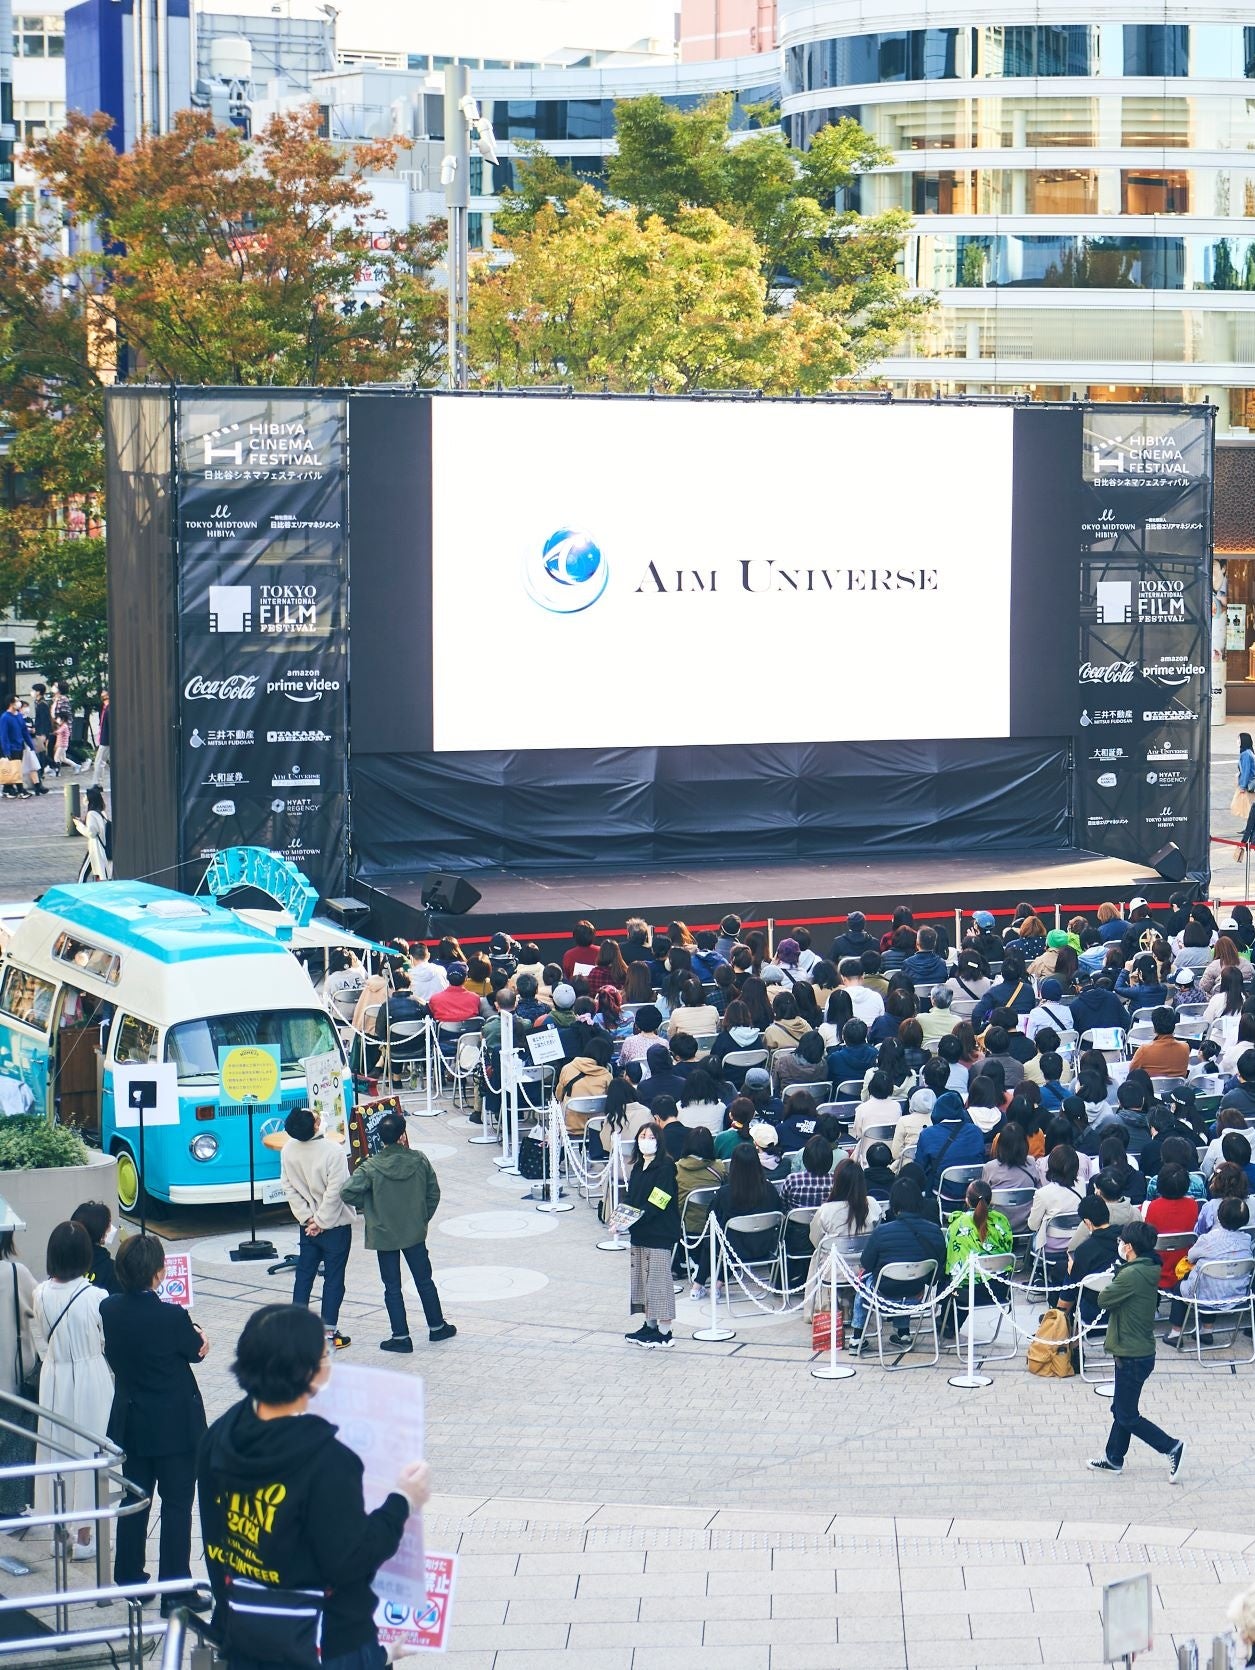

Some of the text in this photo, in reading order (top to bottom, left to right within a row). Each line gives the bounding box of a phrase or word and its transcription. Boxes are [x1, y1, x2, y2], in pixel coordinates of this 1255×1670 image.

[250, 423, 306, 435] HIBIYA
[250, 439, 314, 450] CINEMA
[1129, 436, 1176, 446] HIBIYA
[250, 454, 322, 466] FESTIVAL
[1129, 450, 1183, 460] CINEMA
[1129, 464, 1190, 474] FESTIVAL
[204, 470, 323, 480] 日比谷シネマフェスティバル
[1094, 478, 1190, 487] 日比谷シネマフェスティバル
[185, 521, 258, 529] TOKYO MIDTOWN
[270, 521, 341, 529] 日比谷エリアマネジメント
[206, 530, 236, 538] HIBIYA
[260, 585, 317, 598] TOKYO
[1138, 581, 1184, 592] TOKYO
[1138, 598, 1185, 615] FILM
[260, 605, 317, 624] FILM
[1138, 615, 1185, 623] FESTIVAL
[260, 624, 317, 632] FESTIVAL
[1143, 664, 1206, 677] prime video
[267, 679, 340, 694] prime video
[1094, 709, 1133, 719] 三井不動産
[207, 730, 255, 740] 三井不動産
[1094, 748, 1123, 757] 大和証券
[208, 772, 244, 782] 大和証券
